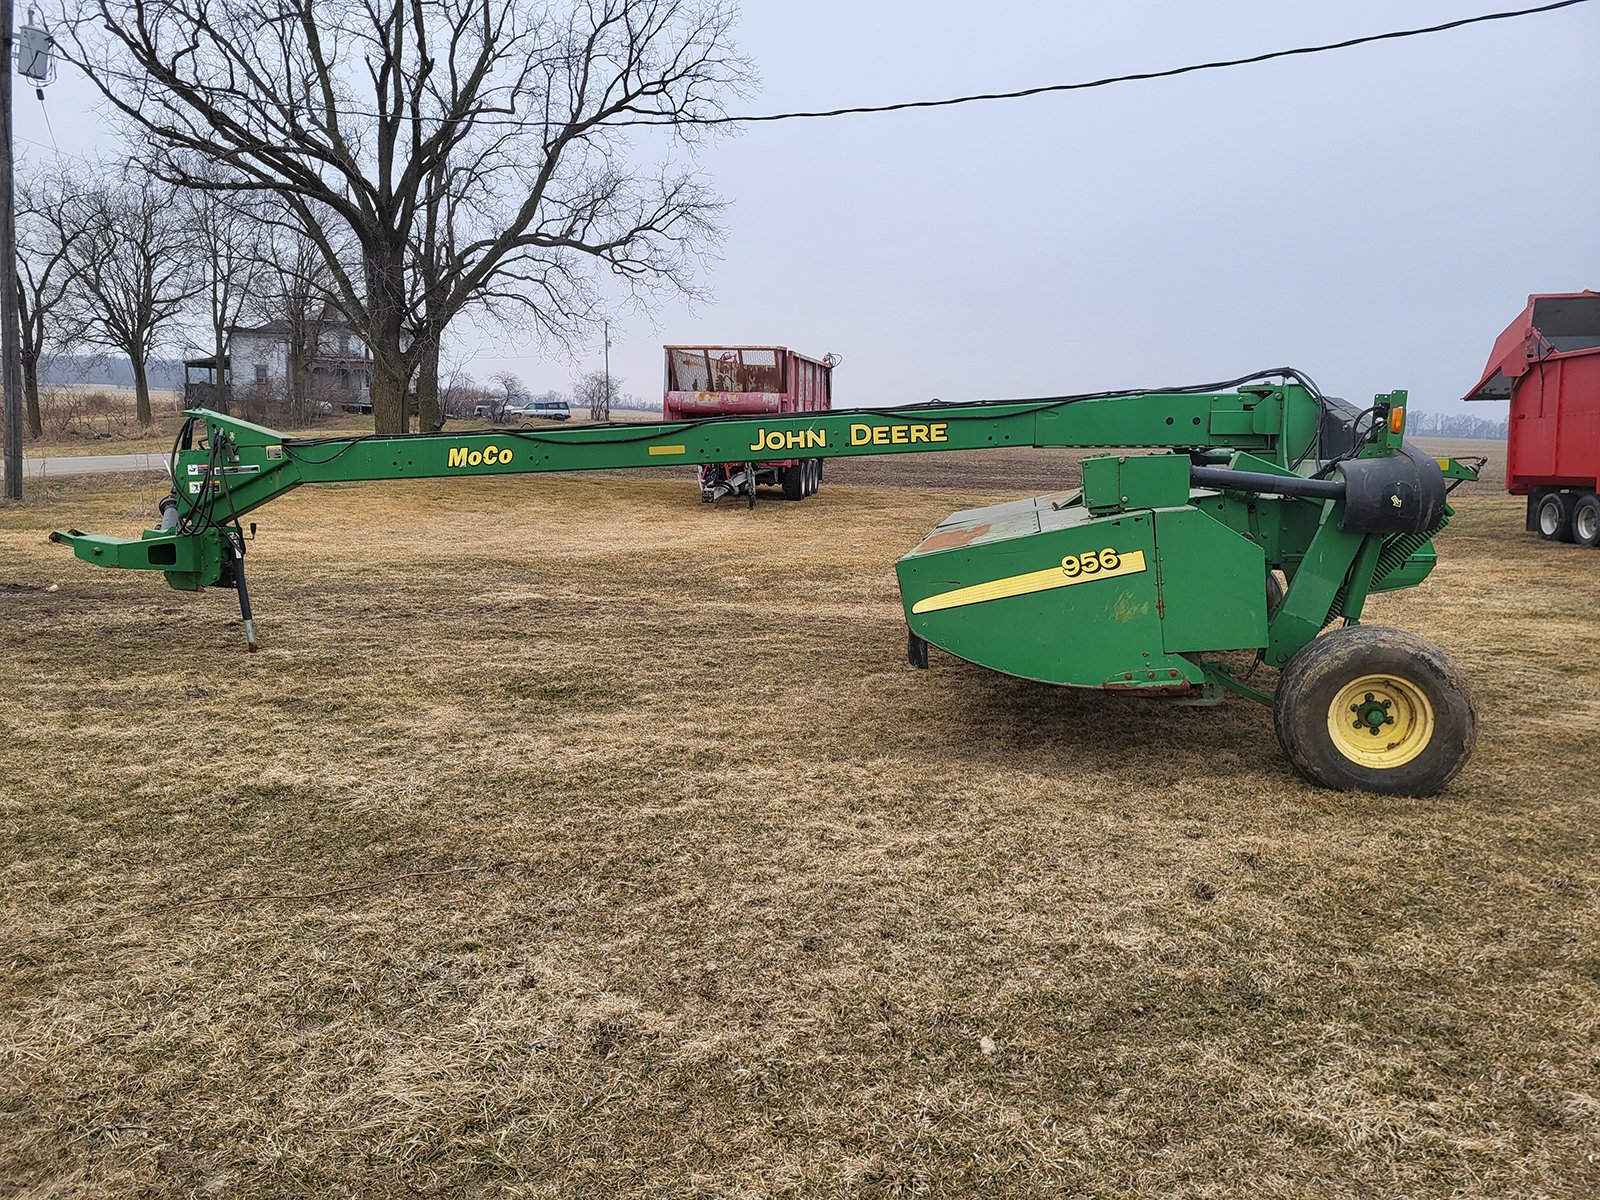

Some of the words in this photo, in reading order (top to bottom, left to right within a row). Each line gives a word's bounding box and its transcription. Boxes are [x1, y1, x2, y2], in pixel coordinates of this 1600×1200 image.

[750, 428, 826, 451] JOHN
[850, 423, 948, 446] DEERE
[448, 445, 513, 468] MoCo
[1061, 547, 1121, 578] 956
